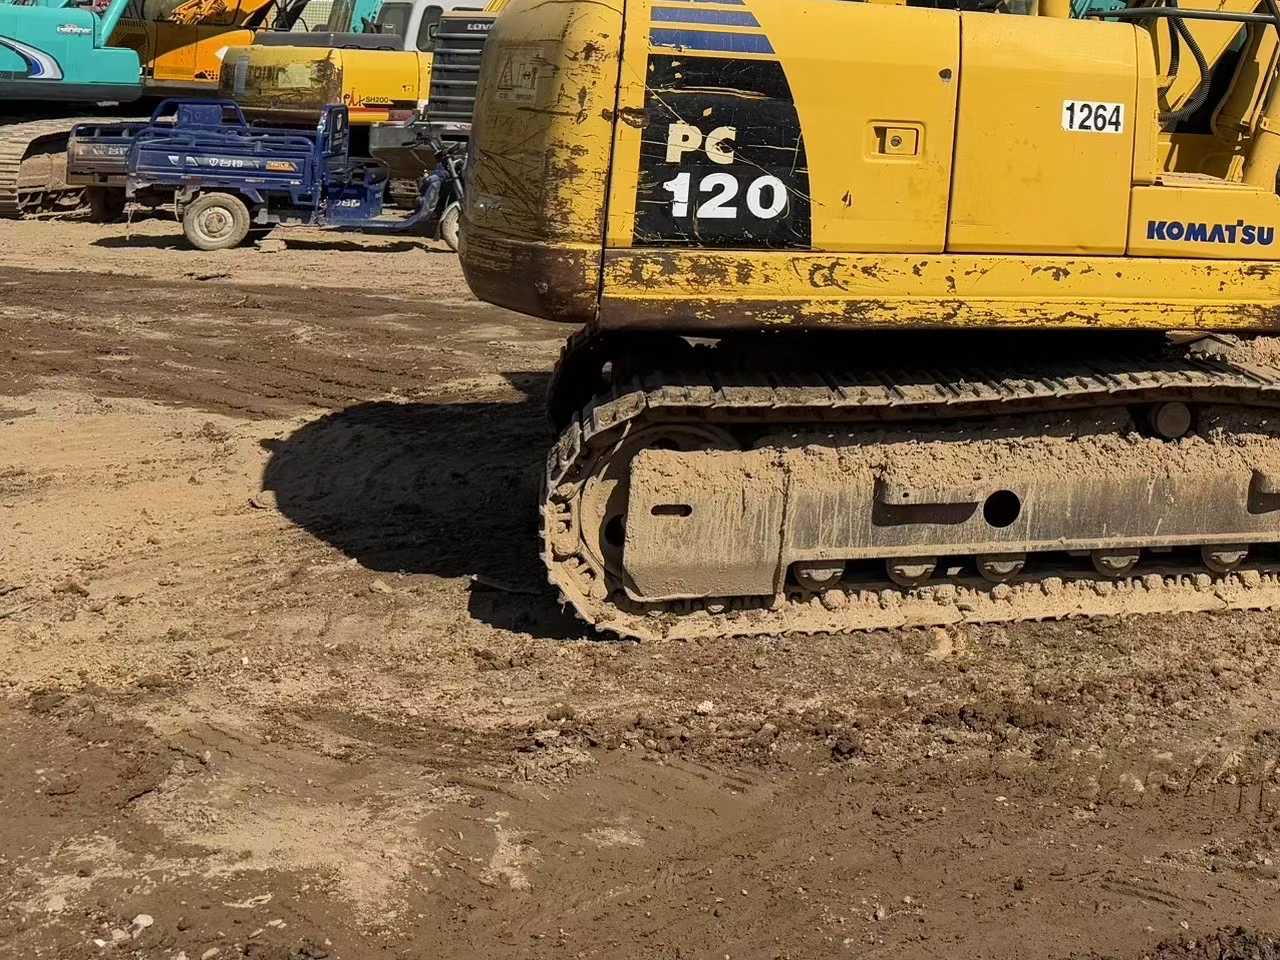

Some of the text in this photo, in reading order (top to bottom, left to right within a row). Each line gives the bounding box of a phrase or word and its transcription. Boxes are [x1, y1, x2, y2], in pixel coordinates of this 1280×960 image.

[1065, 101, 1122, 132] 1264
[665, 121, 737, 165] PC
[662, 172, 788, 219] 120
[1146, 219, 1275, 246] KOMATSU
